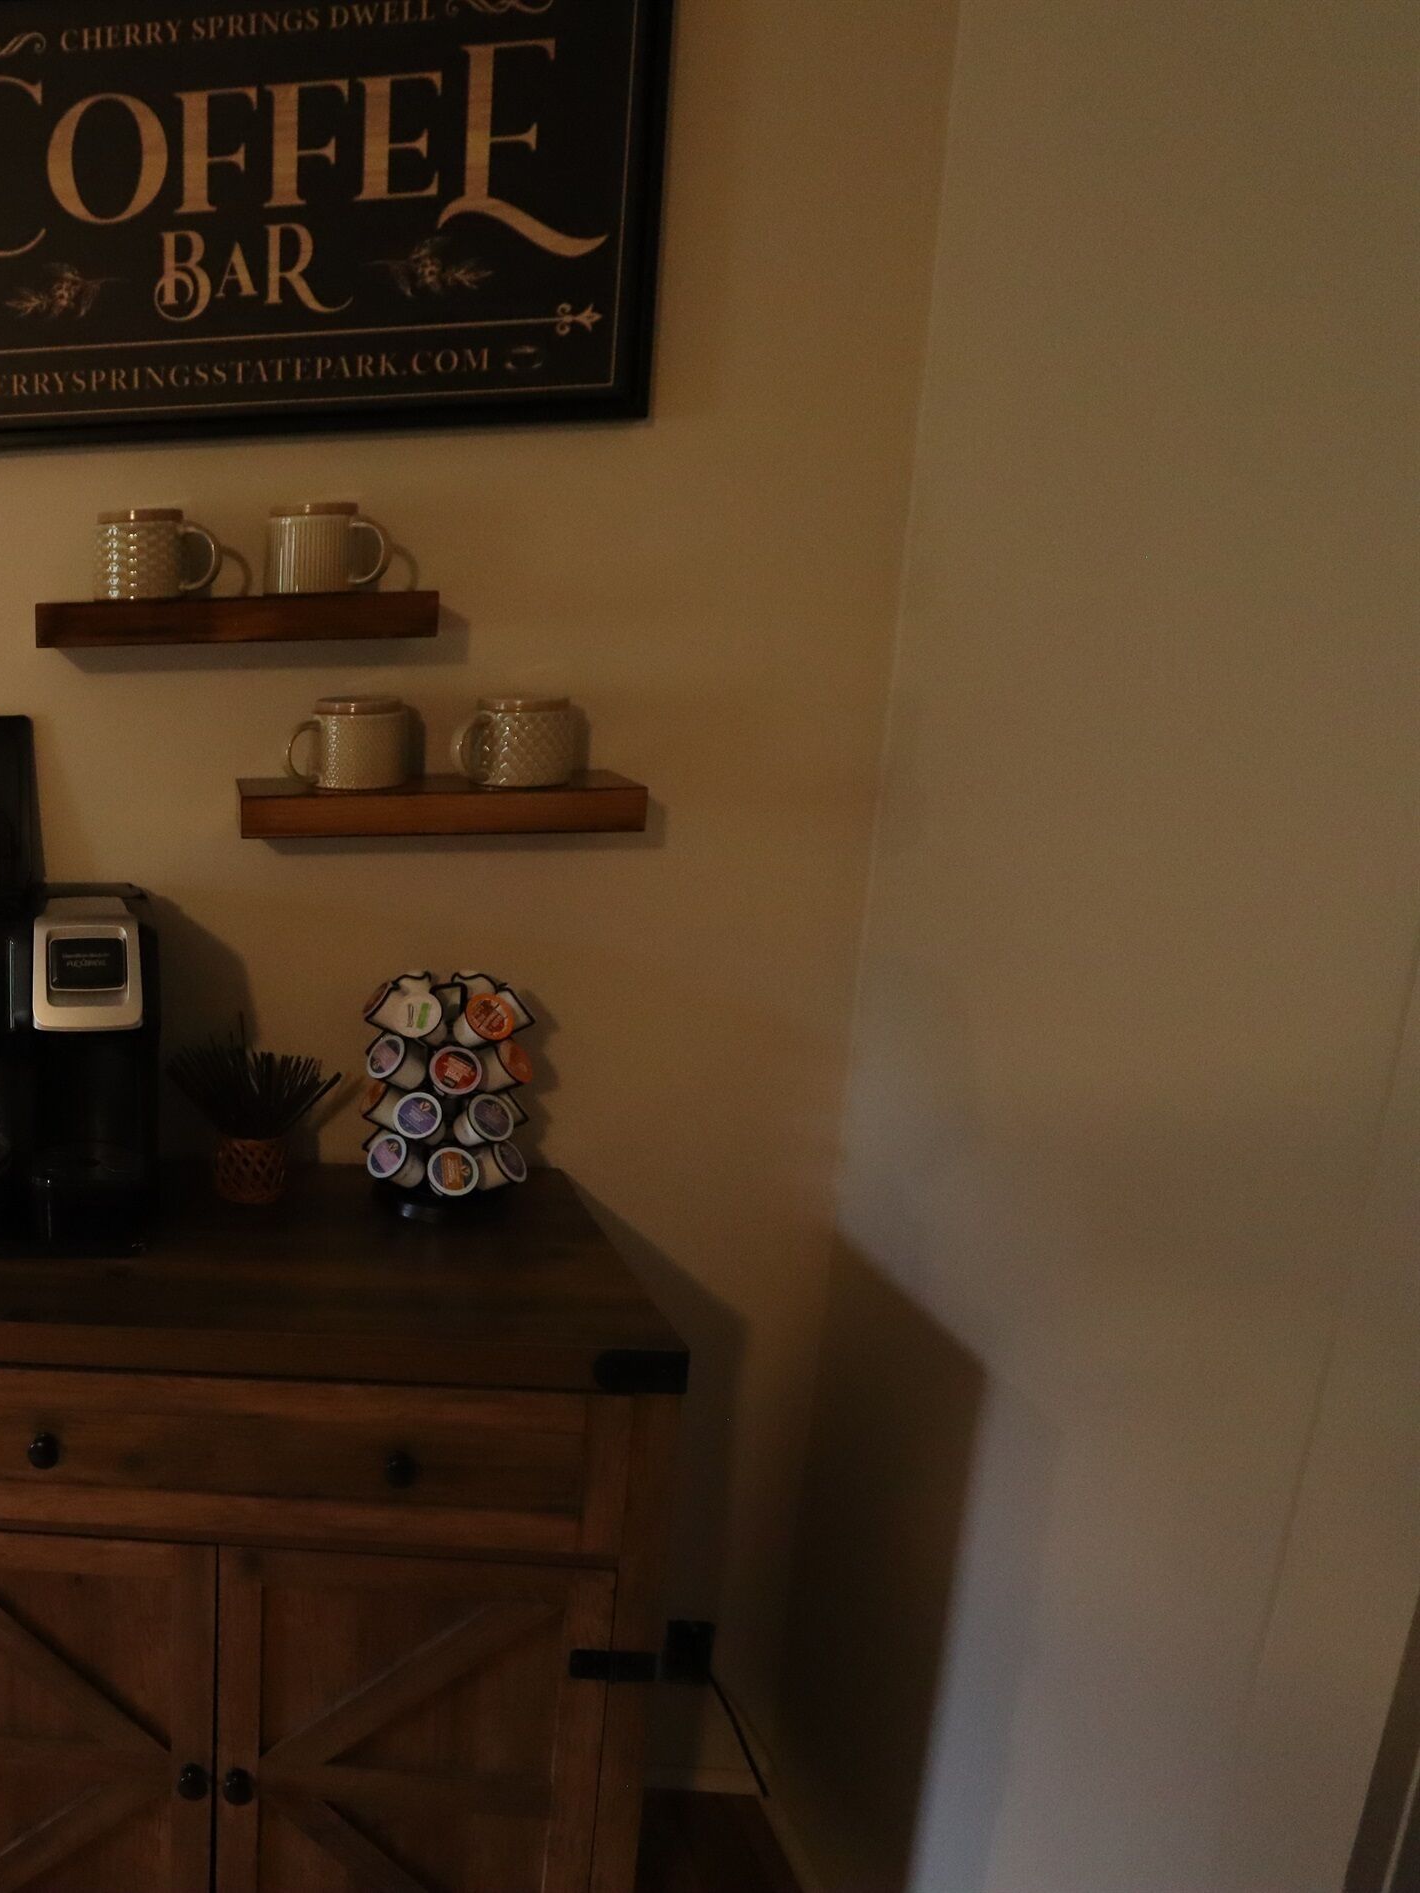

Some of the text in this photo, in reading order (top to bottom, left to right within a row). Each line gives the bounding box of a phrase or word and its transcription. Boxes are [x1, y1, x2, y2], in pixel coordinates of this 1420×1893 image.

[59, 0, 436, 53] CHERRY SPRINGS DWELL
[153, 222, 353, 322] BAR
